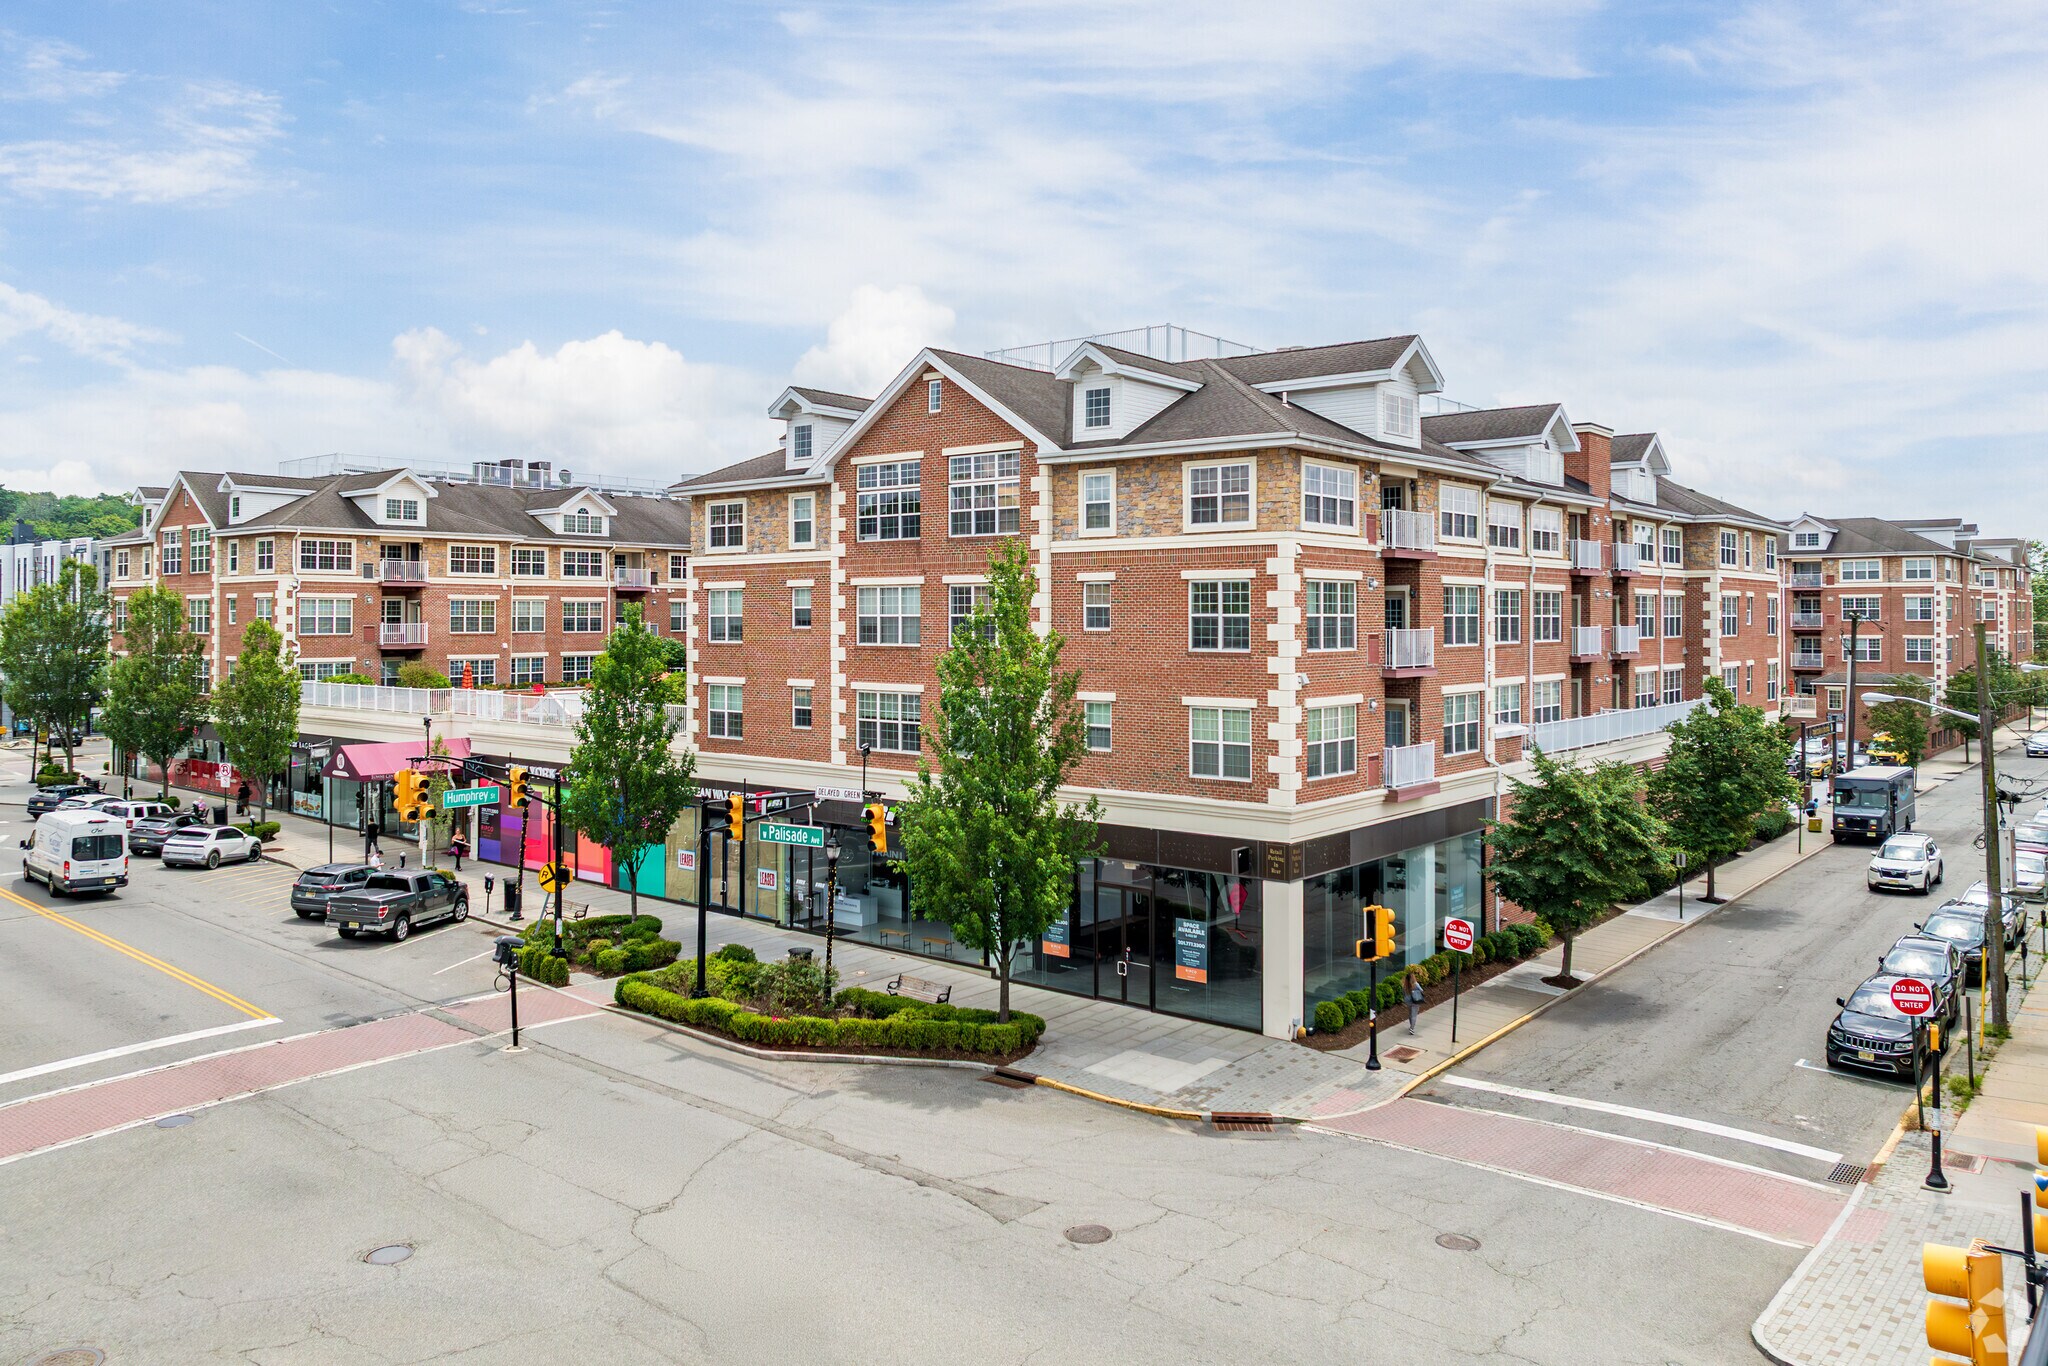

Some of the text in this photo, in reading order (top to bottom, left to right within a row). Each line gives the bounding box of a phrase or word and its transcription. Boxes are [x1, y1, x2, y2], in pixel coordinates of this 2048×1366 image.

[529, 765, 557, 779] YORK
[447, 791, 489, 805] Humphrey
[818, 787, 861, 798] DELAYED GREEN
[768, 826, 808, 843] Palisade
[680, 853, 693, 867] LEASED
[1268, 854, 1285, 863] Parking
[542, 870, 548, 878] R
[760, 872, 775, 886] LEASED
[1178, 926, 1205, 936] AVAILABLE
[1183, 922, 1200, 930] SPACE
[1451, 938, 1467, 946] ENTER
